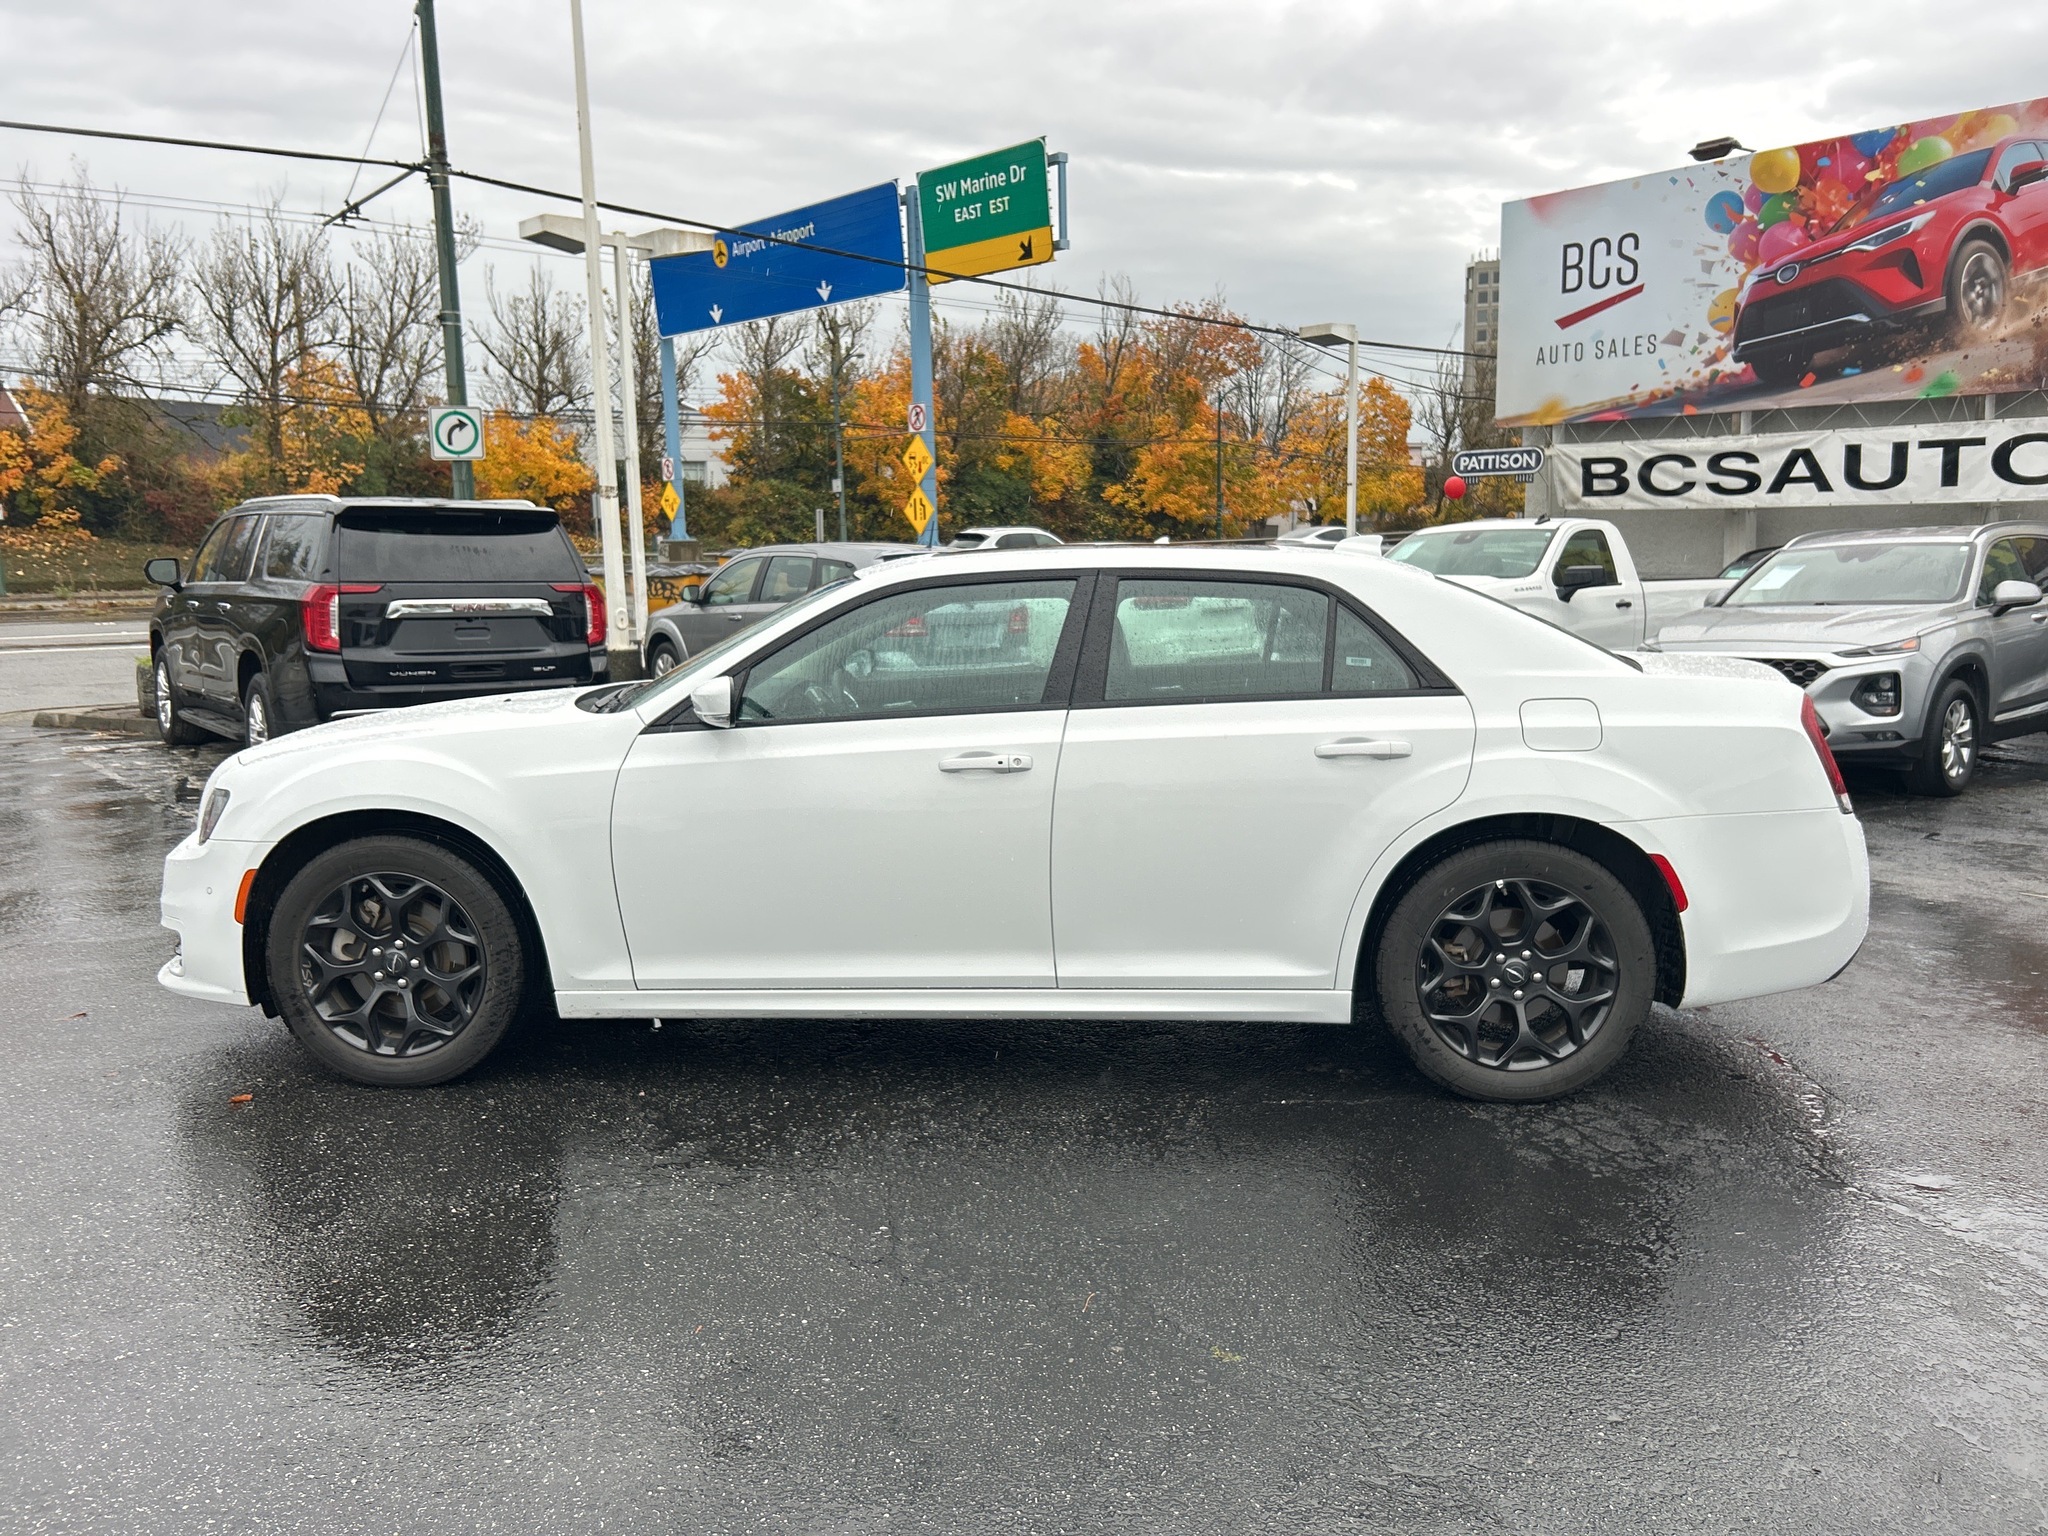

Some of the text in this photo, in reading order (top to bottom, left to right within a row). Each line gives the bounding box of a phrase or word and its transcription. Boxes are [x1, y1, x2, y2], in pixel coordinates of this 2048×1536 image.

[935, 165, 1027, 203] SW Marine Dr
[954, 196, 1010, 222] EAST EST
[732, 239, 766, 258] Airport
[1561, 232, 1640, 294] BCS
[1536, 334, 1657, 366] AUTO SALES
[1459, 452, 1537, 471] PATTISON
[1581, 433, 2048, 497] BCSAUTO
